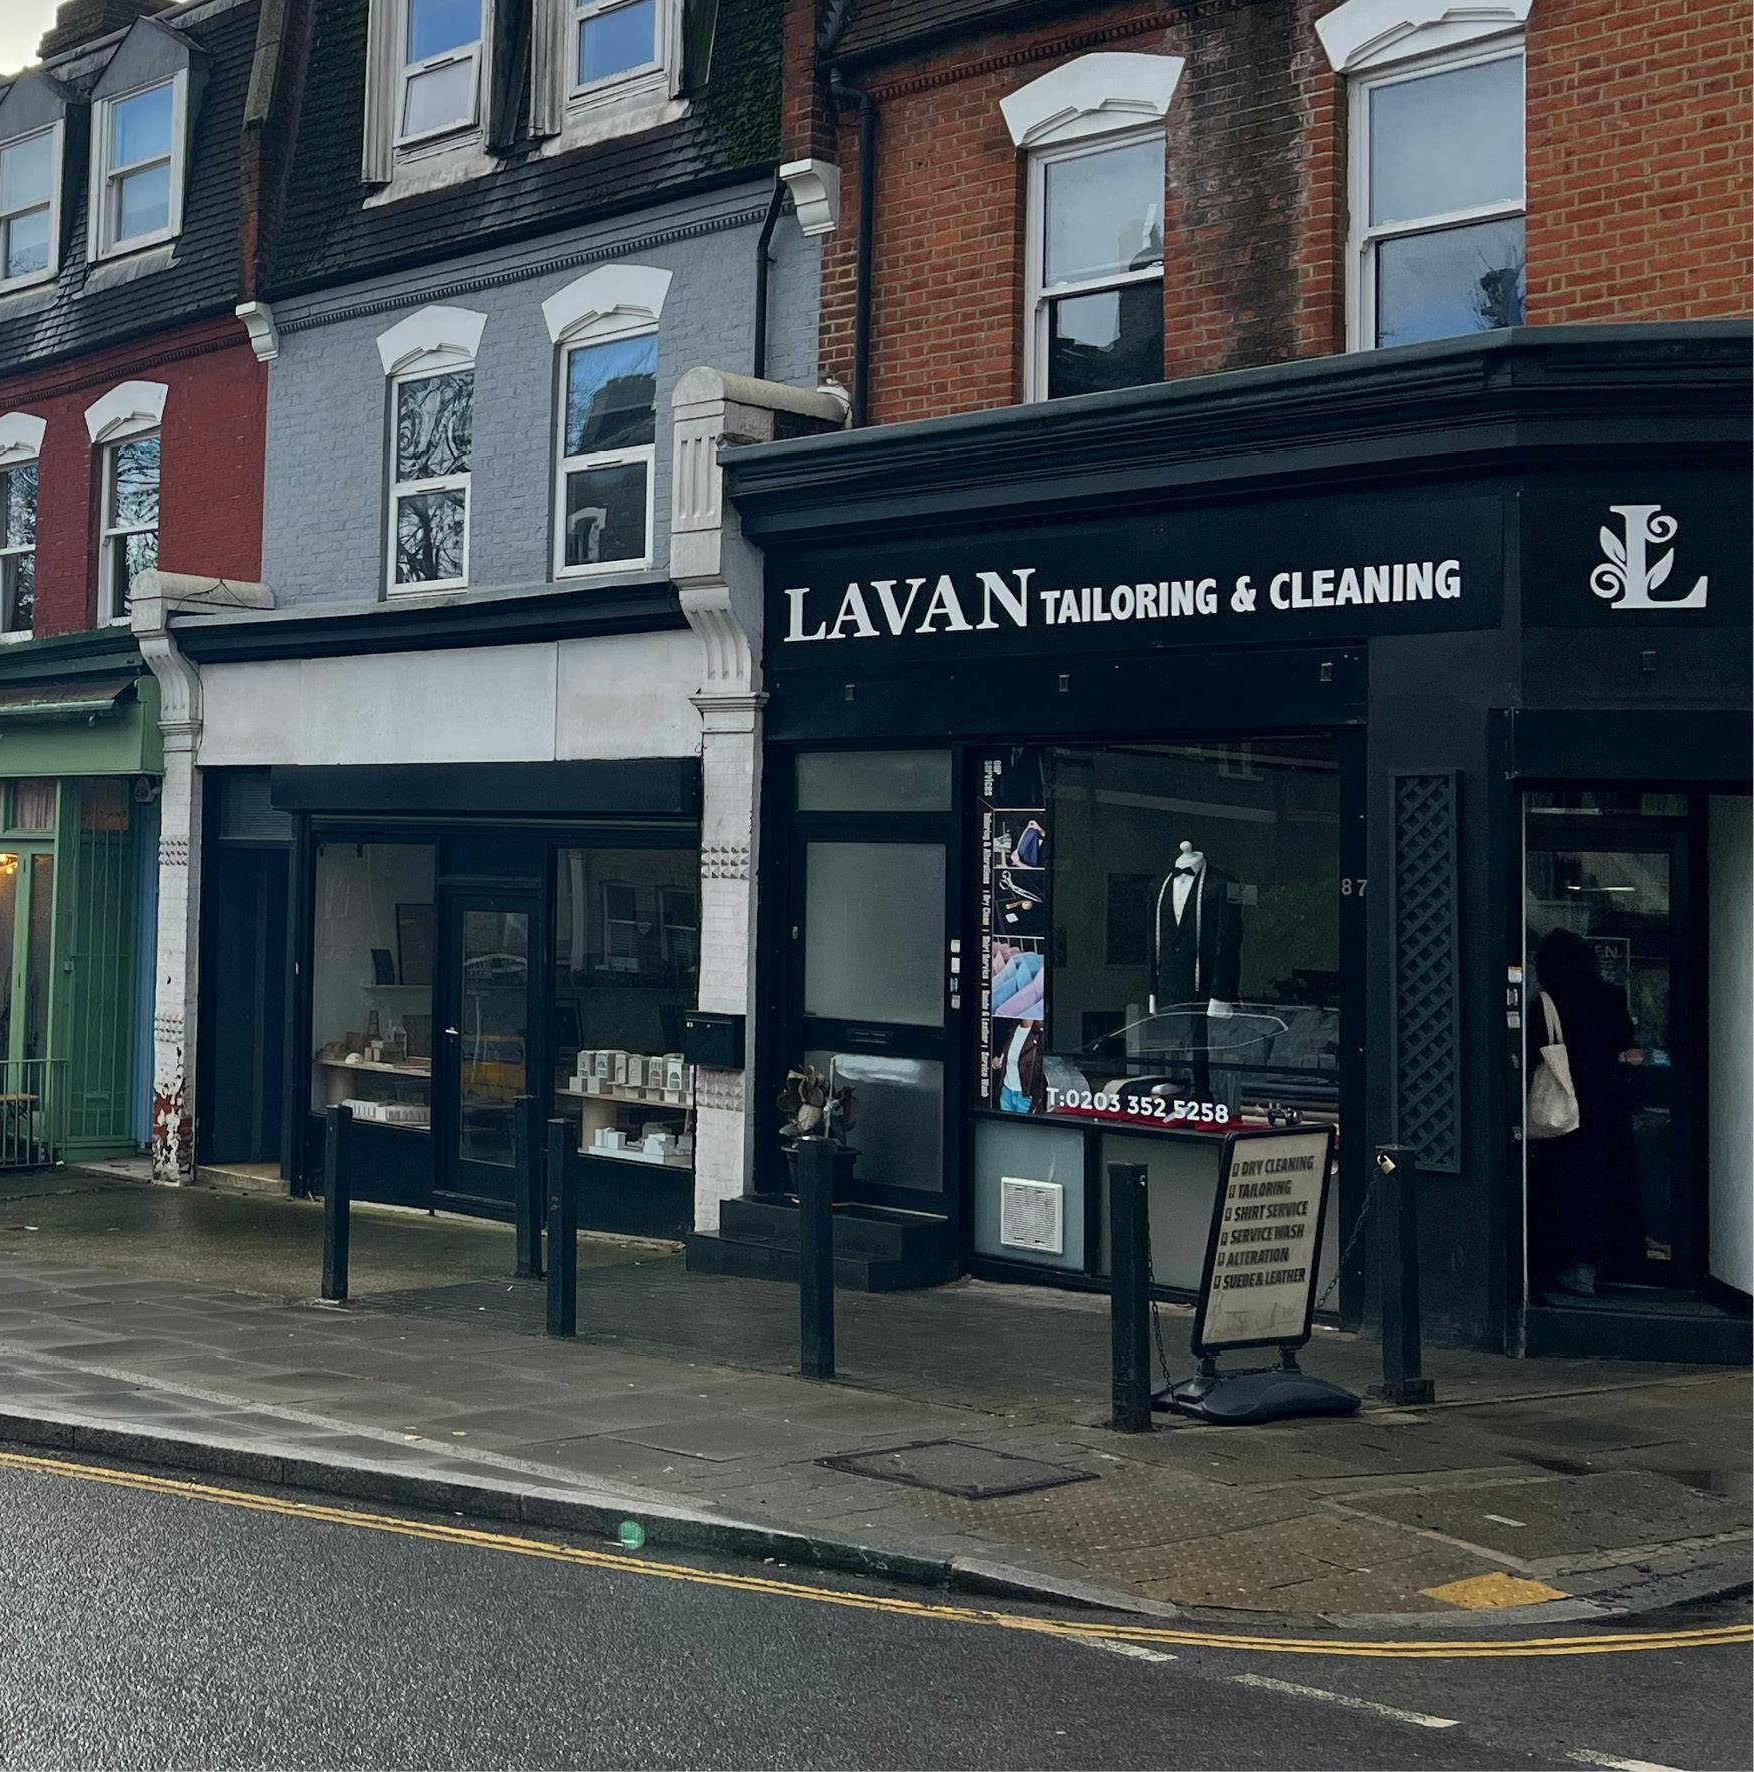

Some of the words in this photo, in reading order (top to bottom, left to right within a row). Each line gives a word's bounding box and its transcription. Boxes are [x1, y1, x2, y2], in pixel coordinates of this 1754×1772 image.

[783, 568, 1036, 642] LAVAN
[1040, 578, 1219, 627] TAILORING
[1230, 575, 1257, 612] &
[1270, 559, 1462, 612] CLEANING
[984, 760, 994, 796] services
[1341, 878, 1368, 896] 87
[1046, 1087, 1121, 1113] T:0203
[1127, 1096, 1167, 1118] 352
[1173, 1100, 1229, 1124] 5258
[1241, 1160, 1264, 1177] DRY
[1265, 1155, 1315, 1175] CLEANING
[1238, 1179, 1293, 1200] TAILORING
[1234, 1204, 1266, 1222] SHIRT
[1266, 1200, 1309, 1220] SERVICE
[1230, 1226, 1273, 1245] SERVICE
[1274, 1224, 1306, 1240] WASH
[1226, 1247, 1290, 1268] ALTERATION
[1222, 1272, 1256, 1290] SUEDE
[1264, 1267, 1306, 1286] LEATHER
